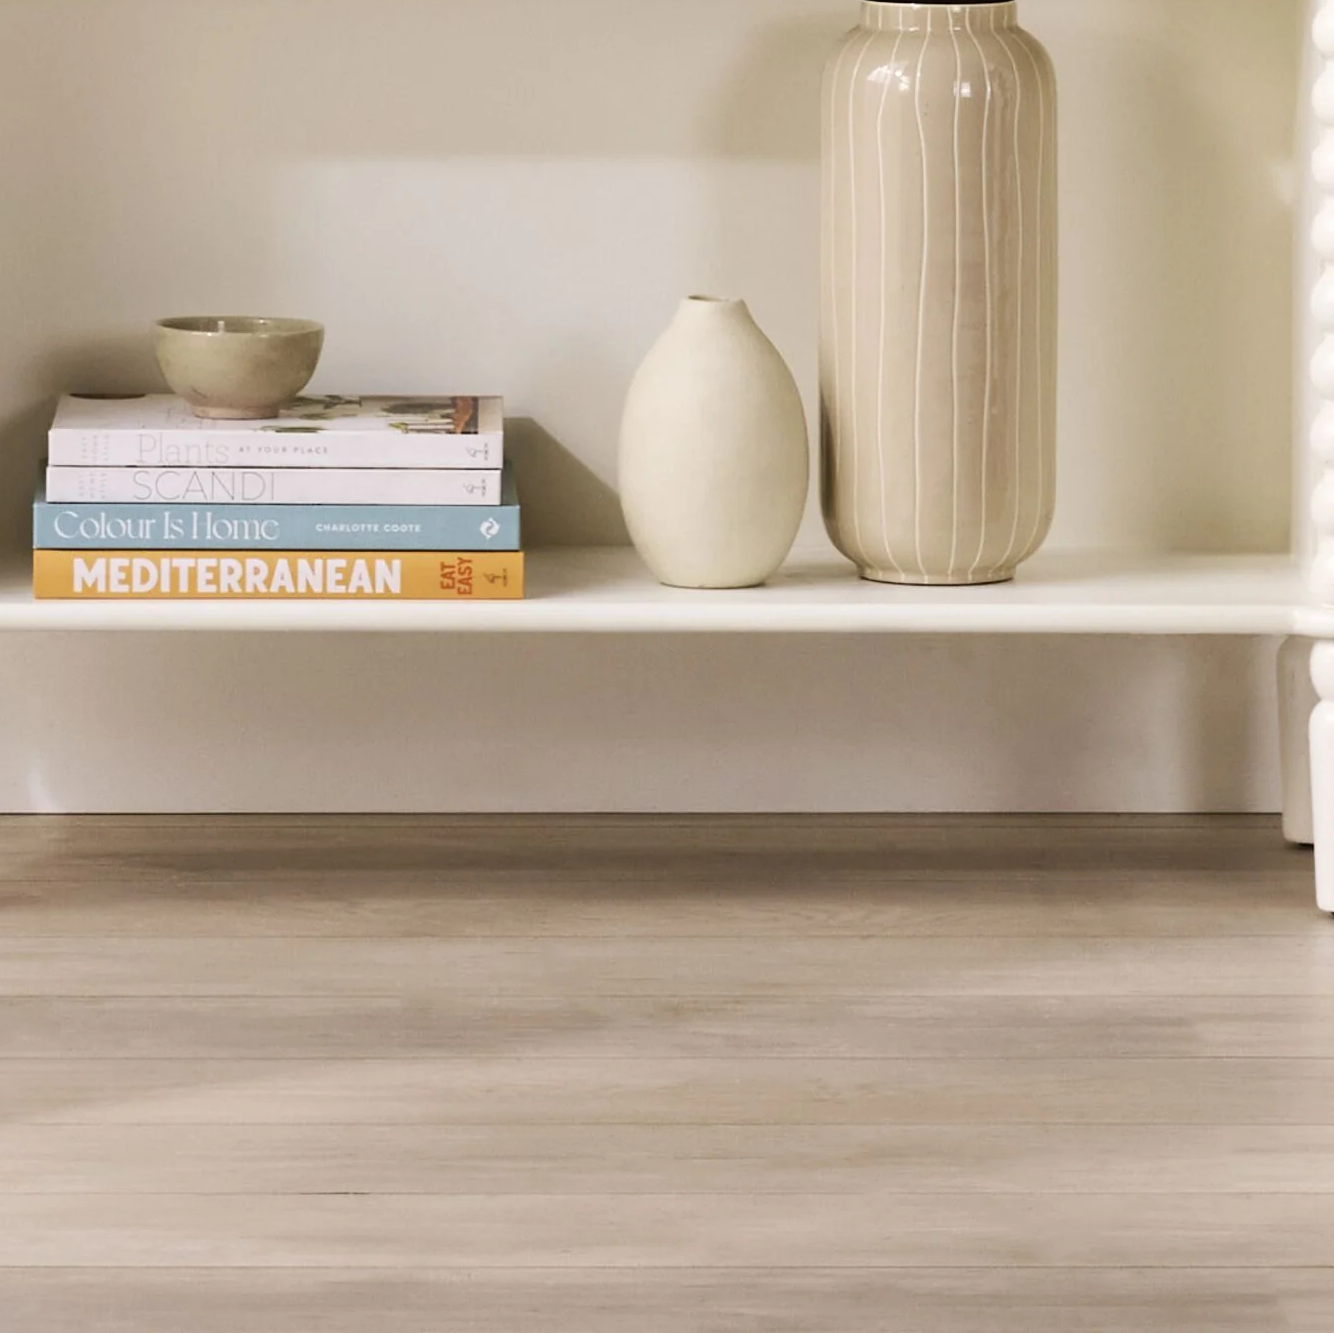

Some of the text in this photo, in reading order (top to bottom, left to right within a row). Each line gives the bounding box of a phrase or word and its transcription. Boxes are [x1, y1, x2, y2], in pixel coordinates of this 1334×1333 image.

[135, 432, 329, 464] Plants AT YOUR PLACE
[132, 470, 276, 501] SCANDI
[53, 511, 281, 540] Colour Is Home
[315, 523, 421, 533] CHARLOTTE COOTE
[72, 557, 402, 594] MEDITERRANEAN
[440, 561, 456, 590] EAT
[457, 556, 473, 595] EASY
